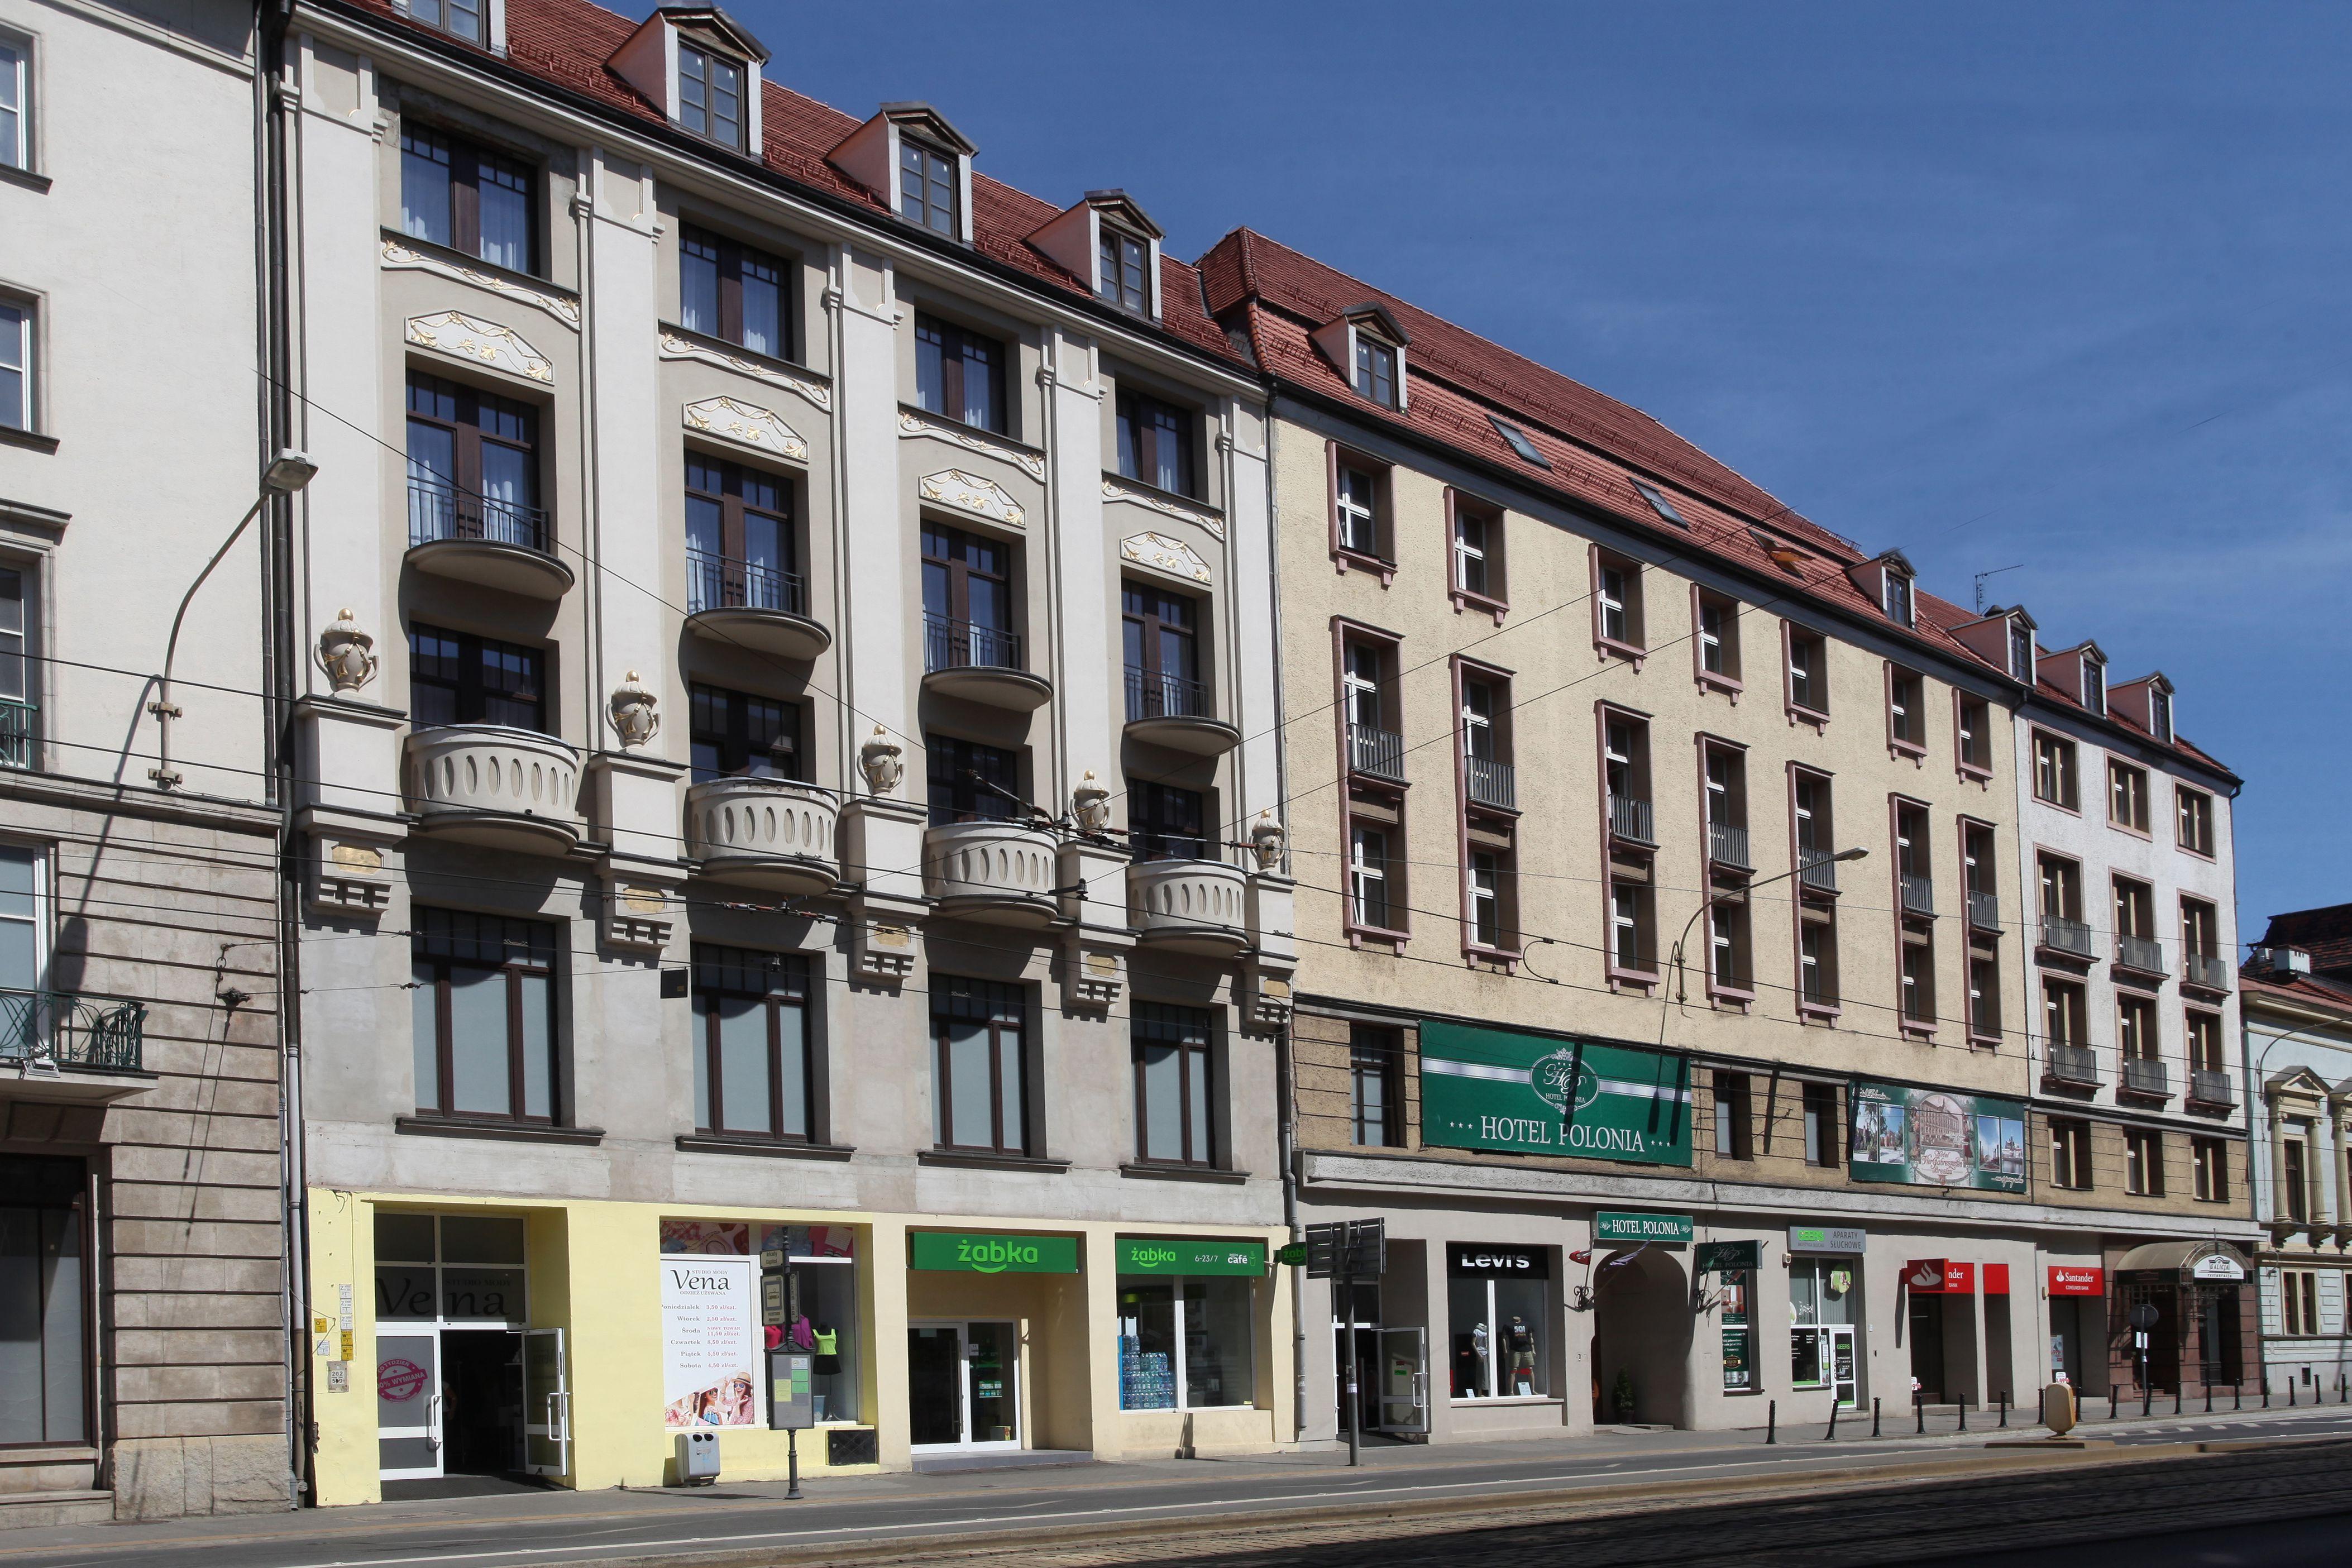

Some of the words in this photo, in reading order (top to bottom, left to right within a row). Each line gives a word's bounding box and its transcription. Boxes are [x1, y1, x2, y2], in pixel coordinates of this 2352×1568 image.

[1480, 1116, 1551, 1144] HOTEL
[1558, 1122, 1645, 1153] POLONIA
[1612, 1220, 1641, 1234] HOTEL
[1643, 1221, 1680, 1235] POLONIA
[1798, 1230, 1824, 1241] GEERS
[957, 1239, 1038, 1264] żabka
[1830, 1240, 1861, 1249] SŁUCHOWE
[1131, 1247, 1176, 1261] żabka
[670, 1269, 732, 1290] Vena
[2065, 1272, 2093, 1283] Santander
[375, 1277, 511, 1316] Vena
[391, 1371, 425, 1385] WYMIANA
